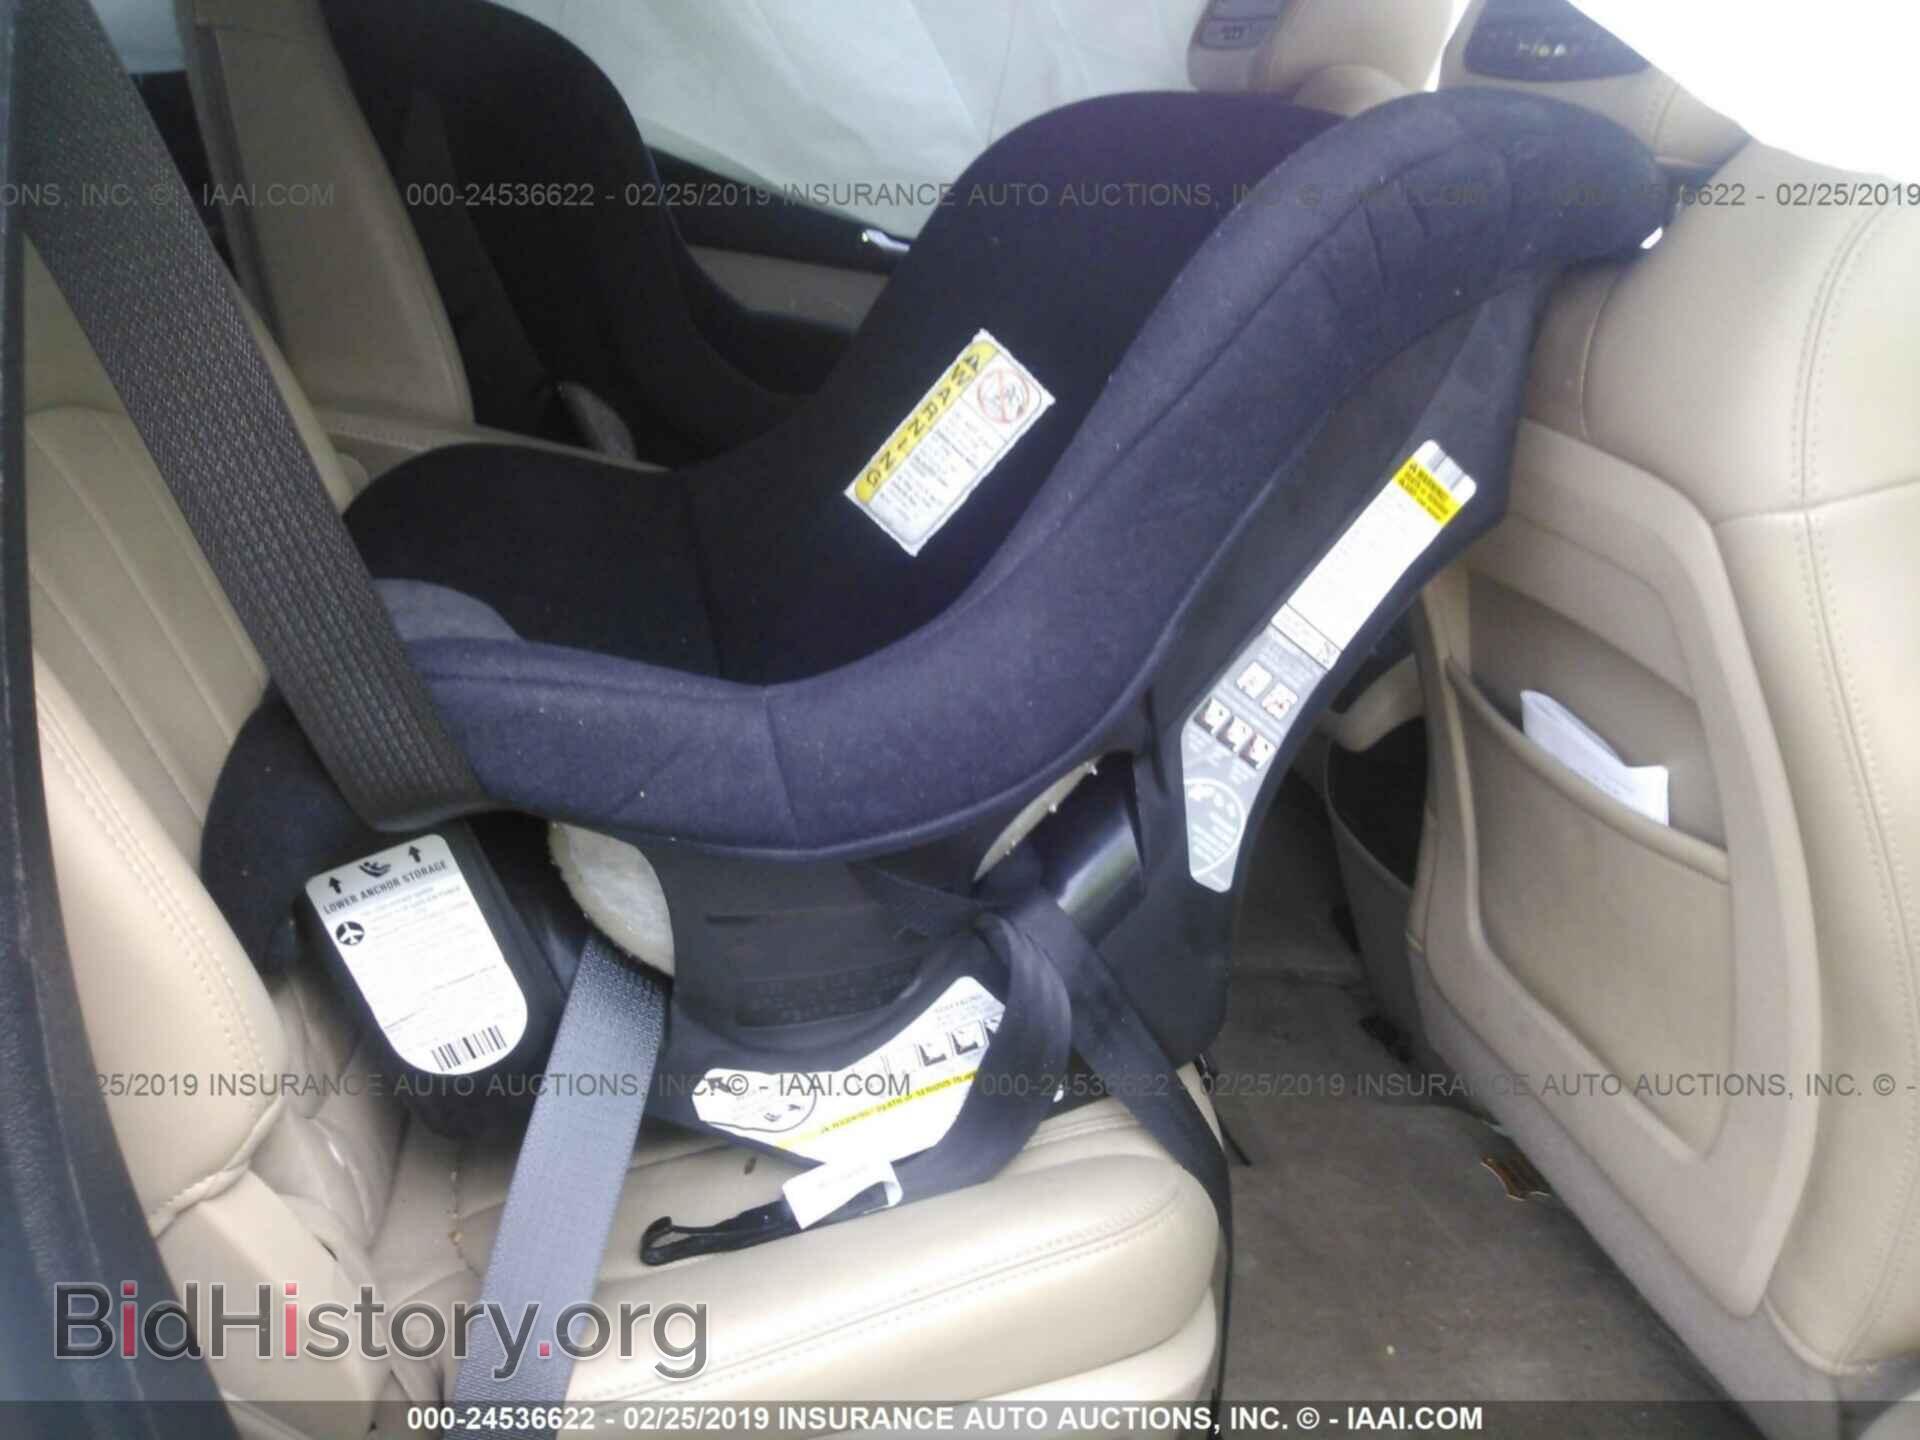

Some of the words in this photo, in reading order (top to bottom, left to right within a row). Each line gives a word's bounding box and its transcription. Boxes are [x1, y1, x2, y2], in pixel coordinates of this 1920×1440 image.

[322, 893, 359, 915] LOWER
[360, 878, 401, 900] ANCHOR
[401, 860, 448, 882] STORAGE
